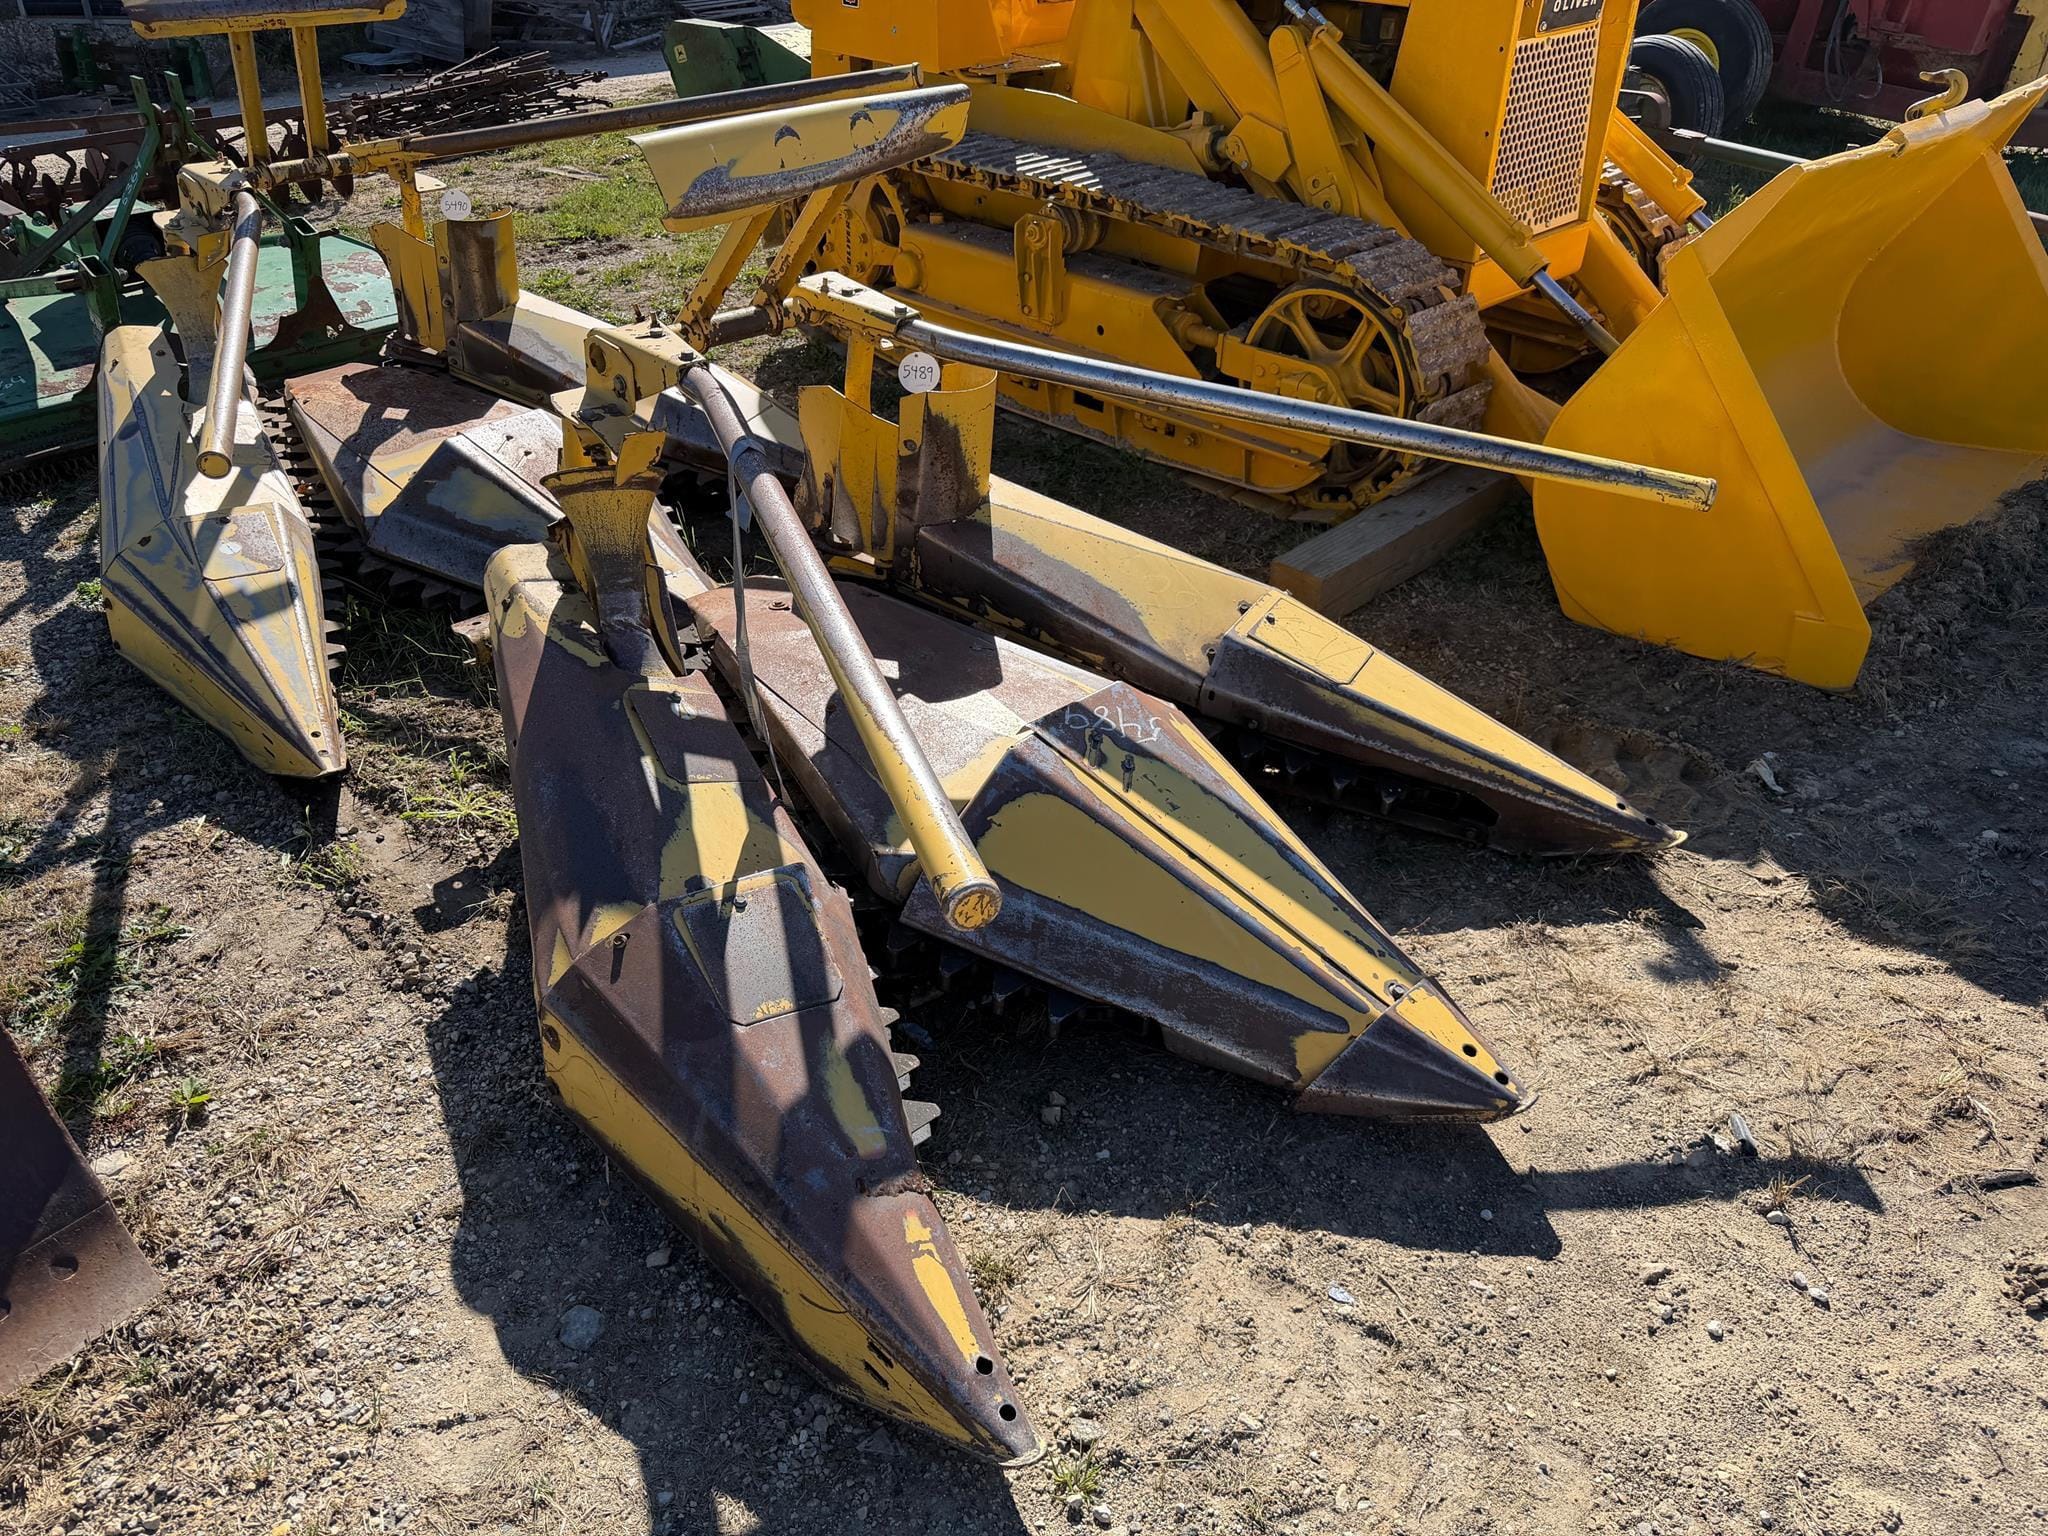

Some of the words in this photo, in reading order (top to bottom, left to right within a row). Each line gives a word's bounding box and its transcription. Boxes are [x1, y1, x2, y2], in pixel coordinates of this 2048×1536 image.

[444, 200, 468, 212] 5490
[903, 364, 934, 382] 5489
[1064, 705, 1162, 744] 5489
